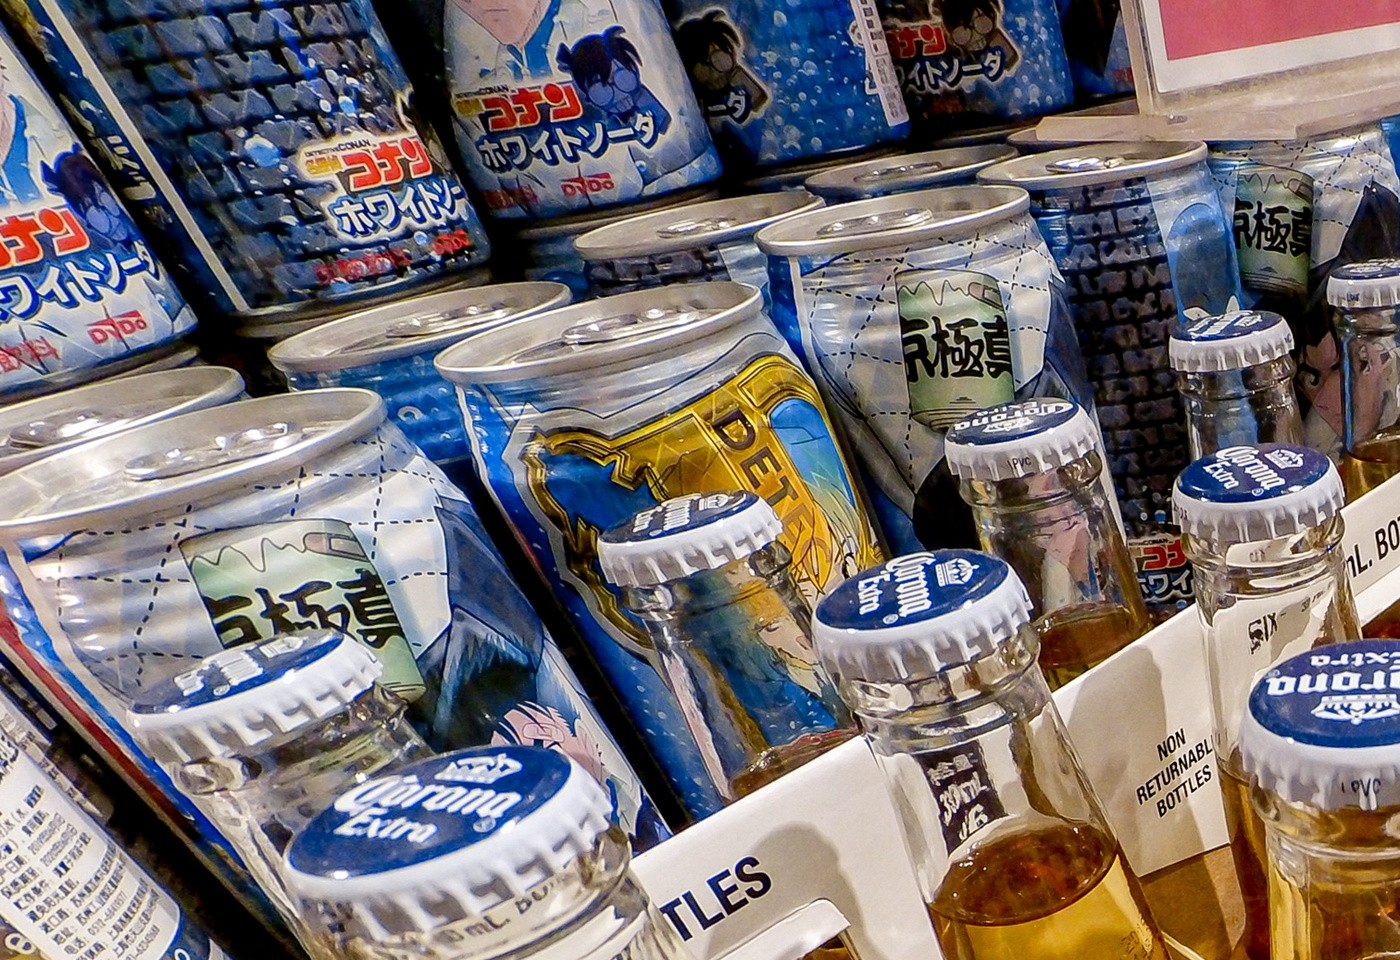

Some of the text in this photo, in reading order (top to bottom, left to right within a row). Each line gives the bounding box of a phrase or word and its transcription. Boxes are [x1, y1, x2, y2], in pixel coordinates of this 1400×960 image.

[484, 83, 582, 131] コナン
[343, 137, 433, 190] コナン
[1202, 460, 1240, 491] Extra
[1215, 446, 1286, 491] Corona
[857, 569, 893, 616] Extra
[886, 552, 936, 618] Corona
[1156, 727, 1187, 762] NON
[1135, 738, 1215, 806] RETURNABL
[1155, 763, 1213, 819] BOTTLES
[333, 774, 522, 818] Corona
[333, 807, 438, 844] Extra
